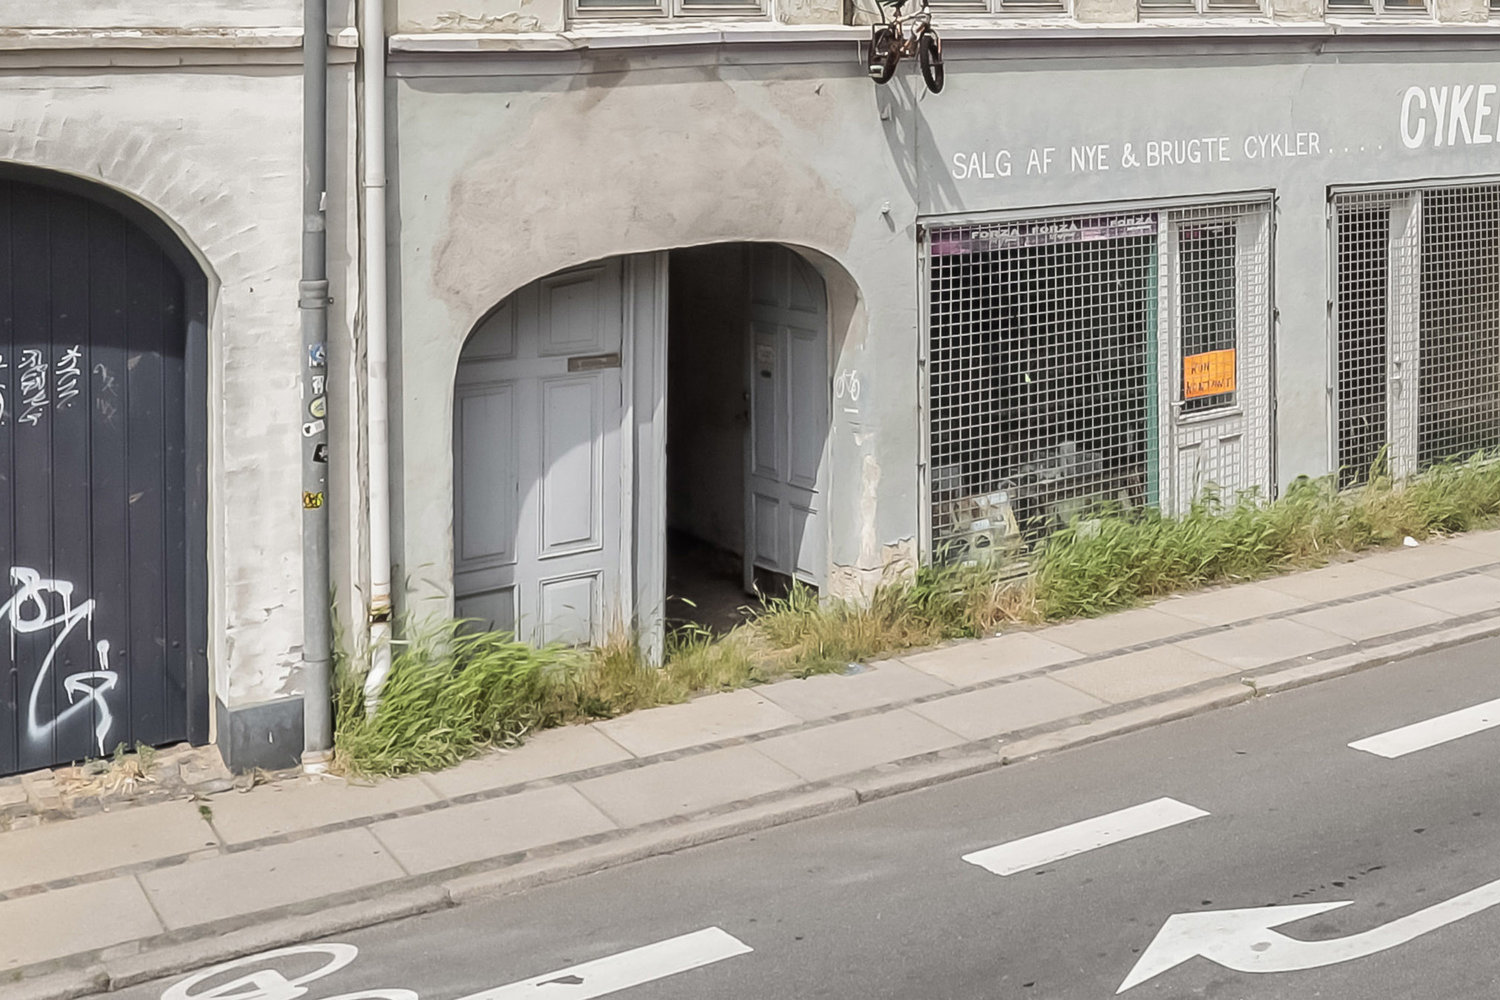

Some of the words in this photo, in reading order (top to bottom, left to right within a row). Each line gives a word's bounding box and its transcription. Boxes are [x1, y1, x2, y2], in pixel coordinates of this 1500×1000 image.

[952, 150, 1012, 180] SALG
[1026, 148, 1056, 175] AF
[1071, 144, 1110, 172] NYE
[1121, 142, 1141, 168] &
[1146, 137, 1230, 167] BRUGTE
[1244, 132, 1321, 159] CYKLER
[971, 228, 1020, 240] FORZA
